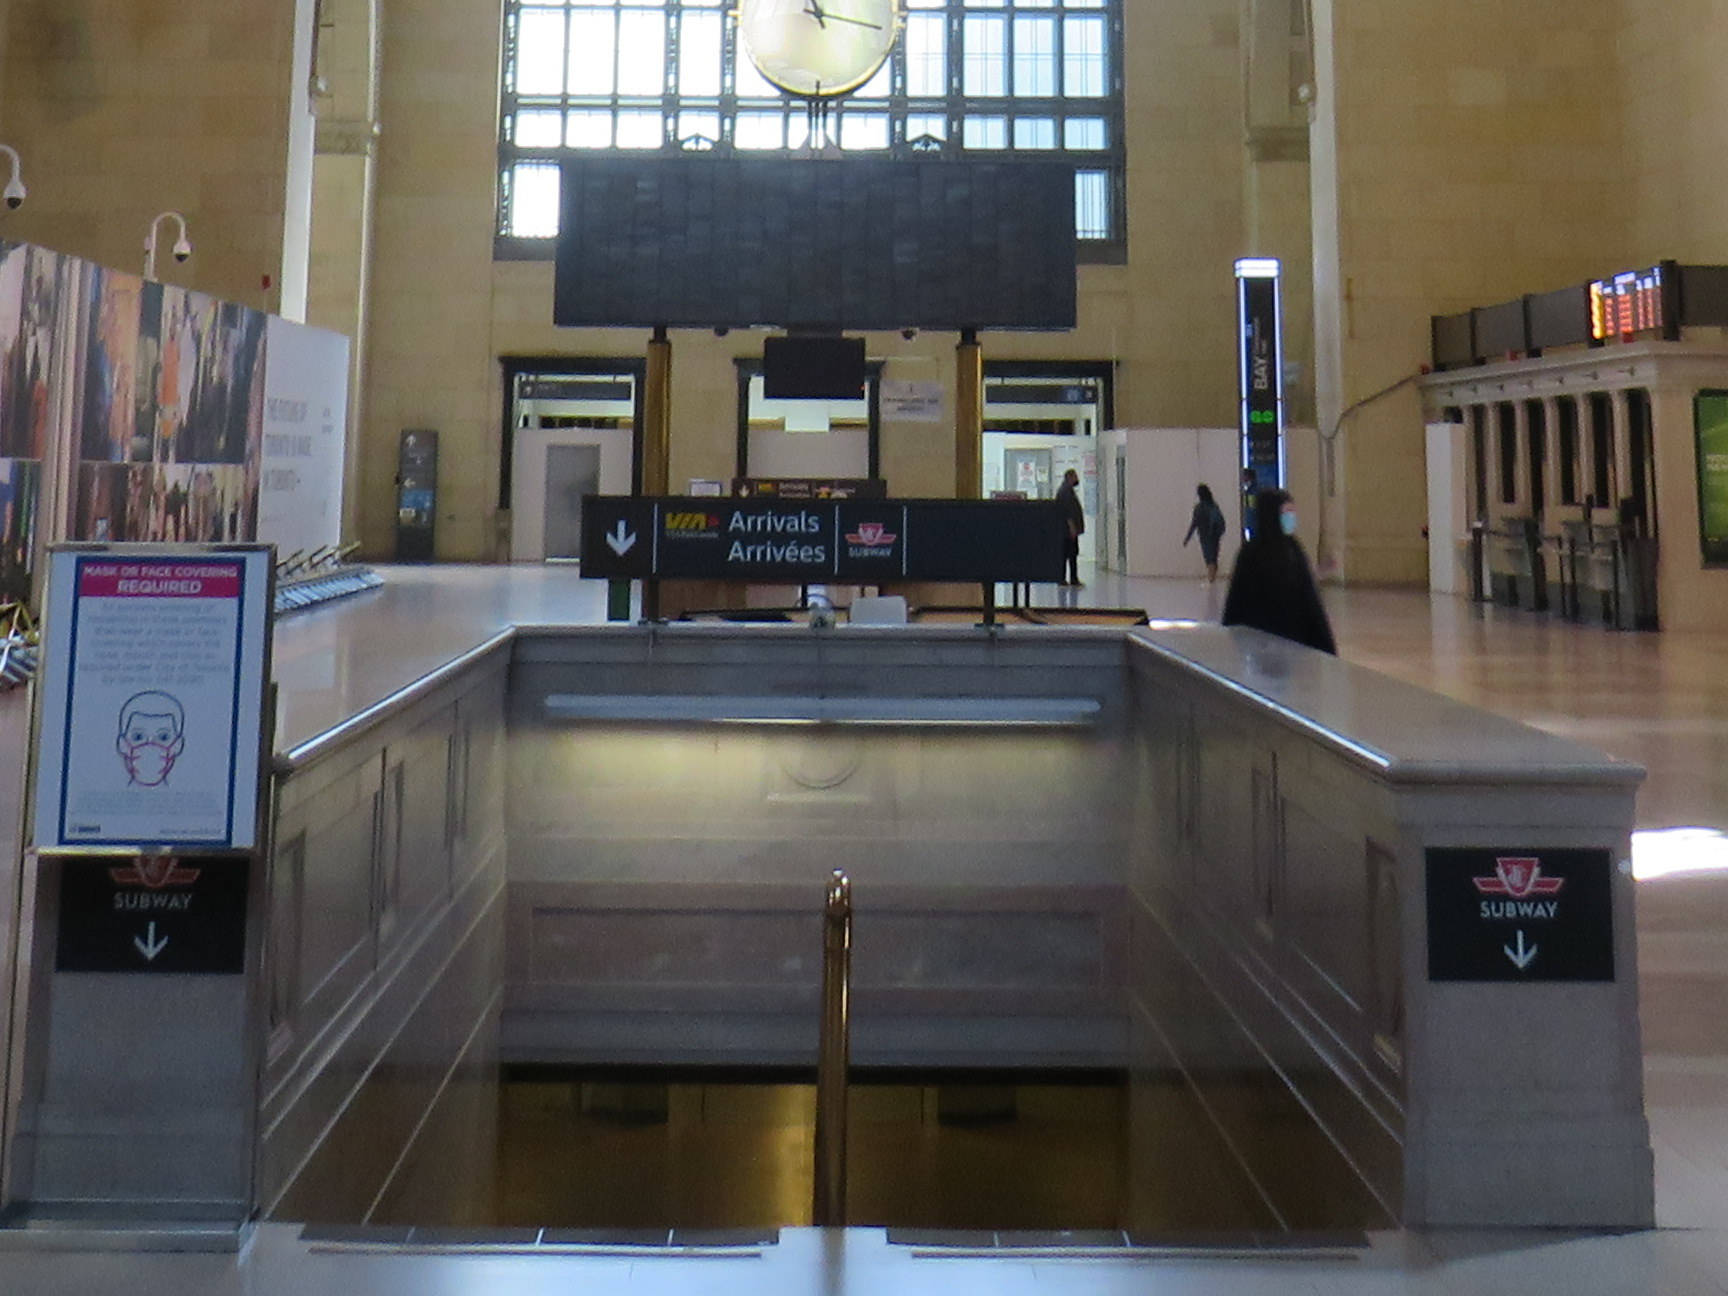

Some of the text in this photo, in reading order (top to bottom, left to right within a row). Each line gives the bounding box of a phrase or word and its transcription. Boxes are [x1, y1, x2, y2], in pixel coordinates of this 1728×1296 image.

[1253, 356, 1269, 390] BAY
[665, 510, 820, 533] VIA Arrivals
[727, 539, 825, 563] Arrivées
[848, 546, 892, 558] SUBWAY
[84, 566, 238, 577] MASK OR FACE COVERING
[117, 579, 203, 595] REQUIRED
[113, 892, 193, 911] SUBWAY
[1480, 901, 1558, 919] SUBWAY
